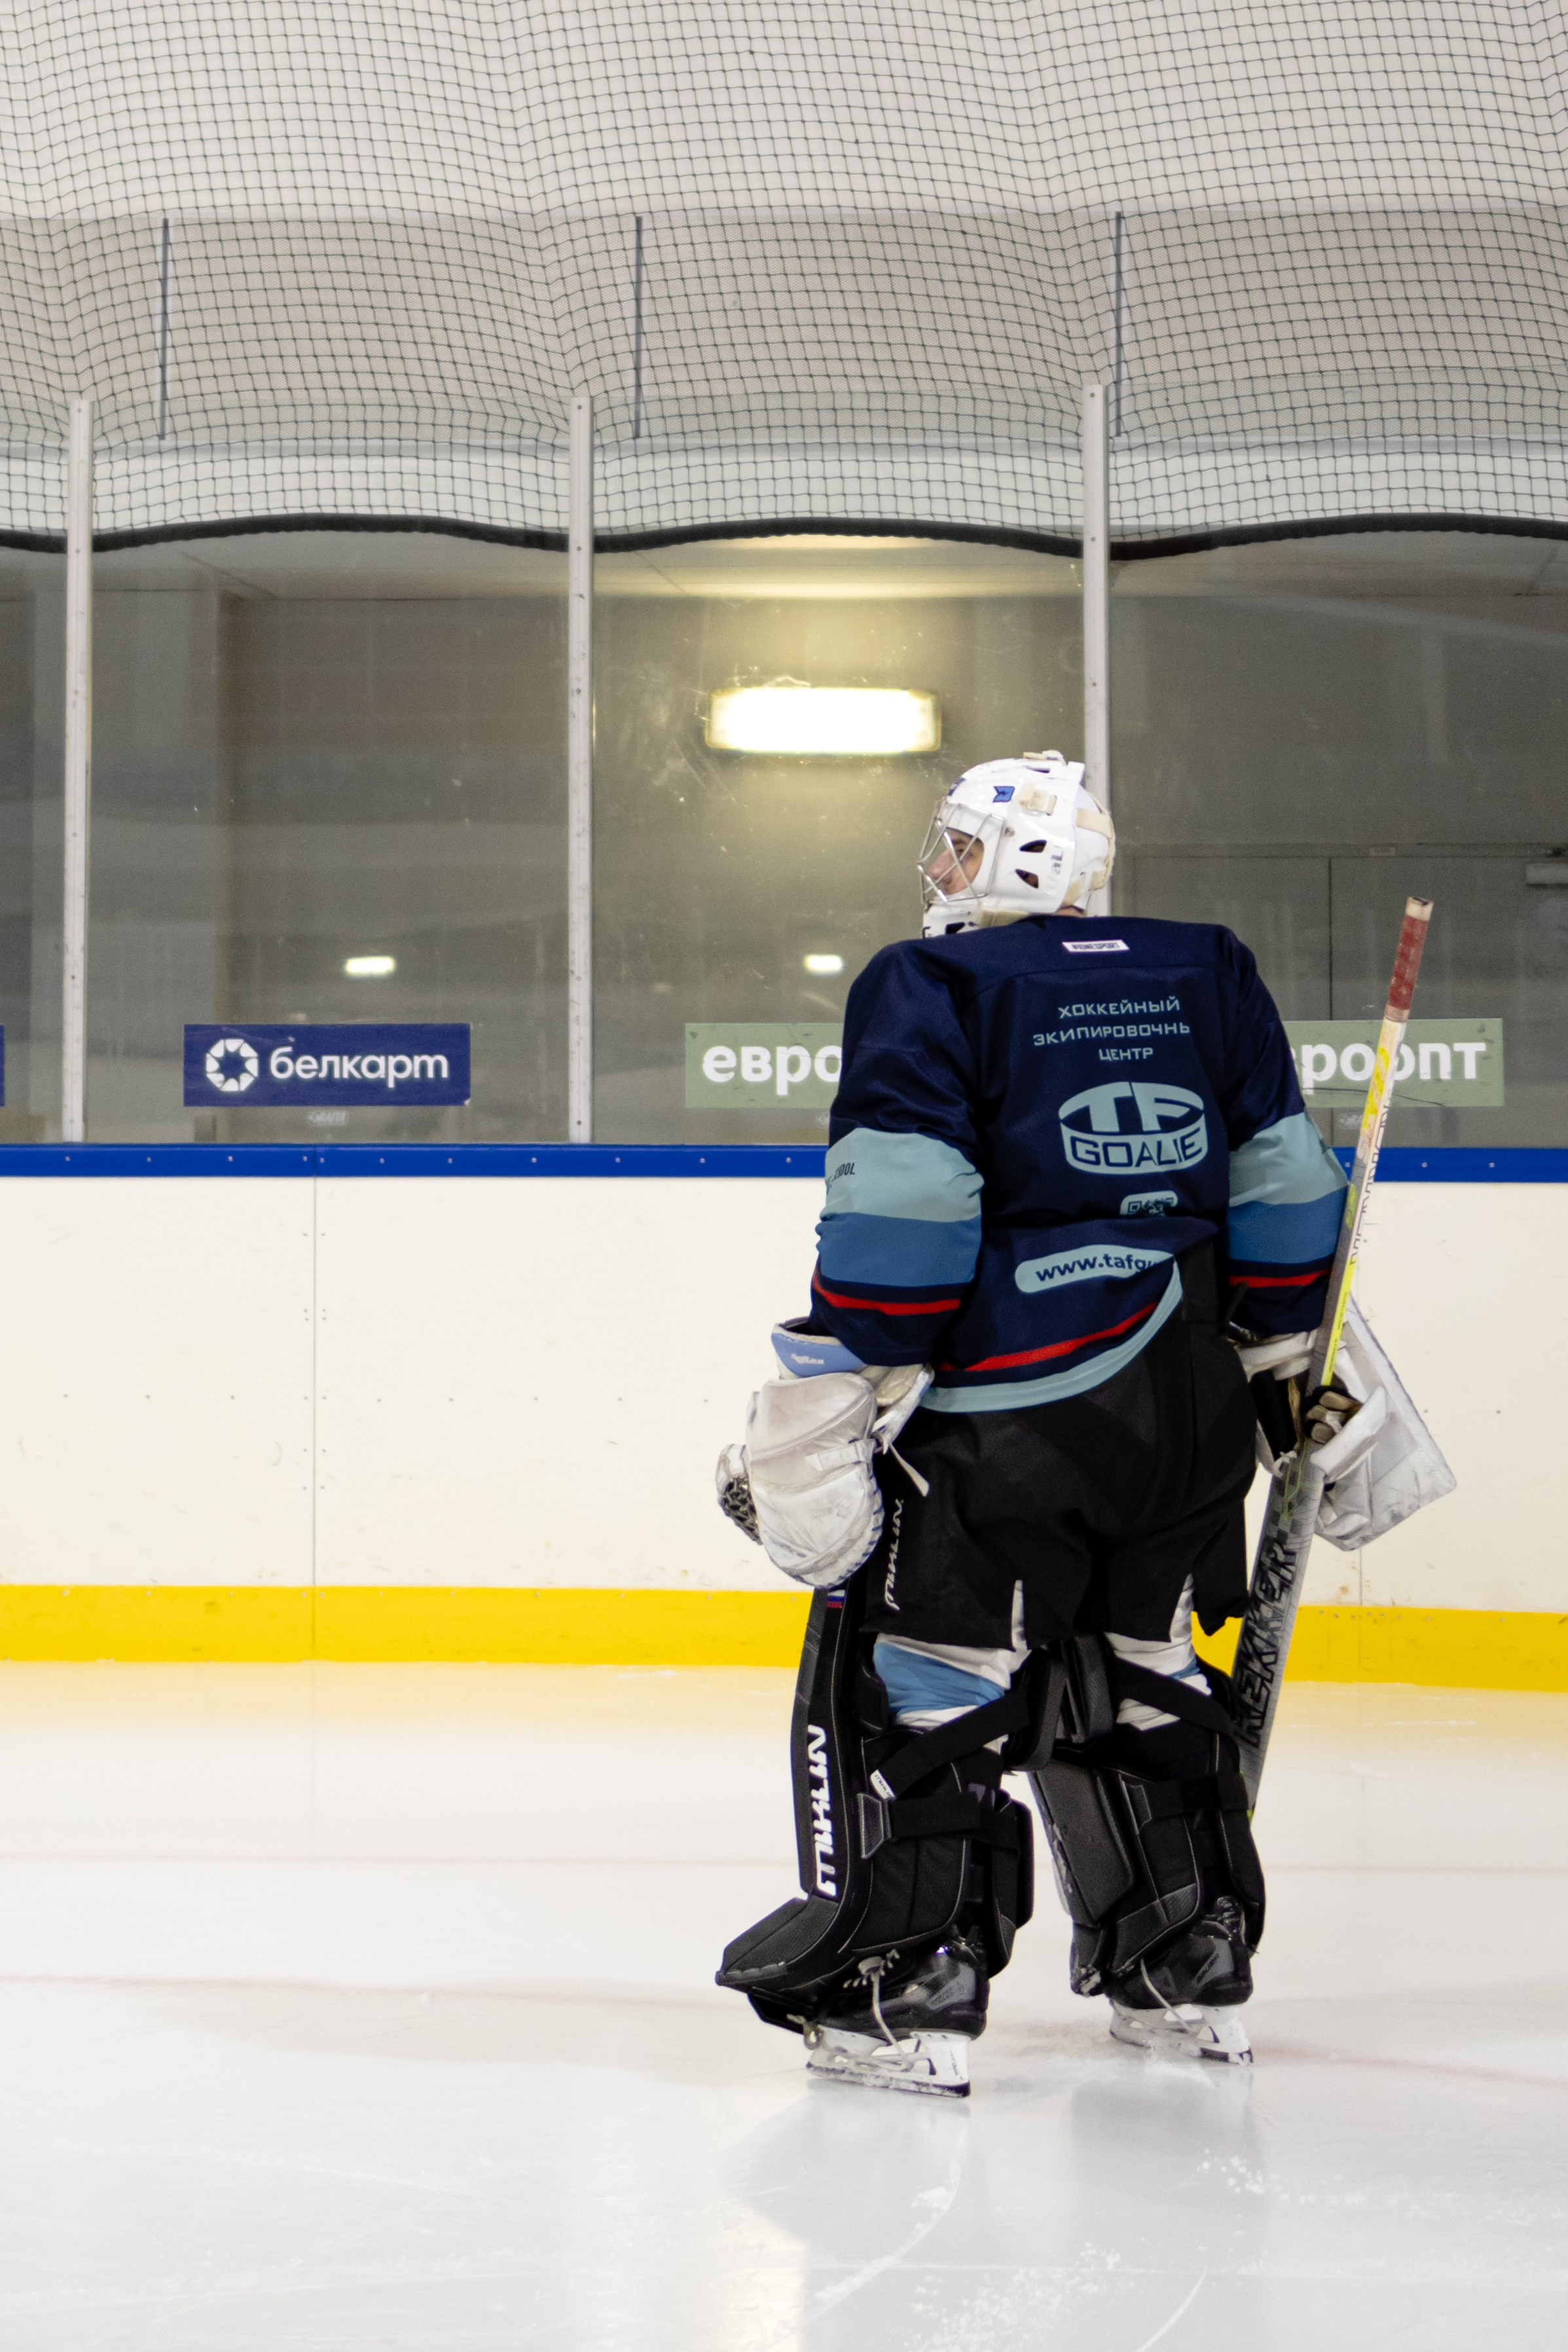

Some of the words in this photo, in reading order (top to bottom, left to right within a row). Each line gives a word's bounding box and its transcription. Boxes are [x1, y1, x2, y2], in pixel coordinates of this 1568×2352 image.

[1057, 995, 1180, 1019] ХОККЕЙНЫЙ
[270, 1046, 449, 1088] белкарт
[1098, 1048, 1154, 1062] ЦЕНТР
[1291, 1042, 1486, 1095] роопт
[1069, 1126, 1203, 1167] GOALIE
